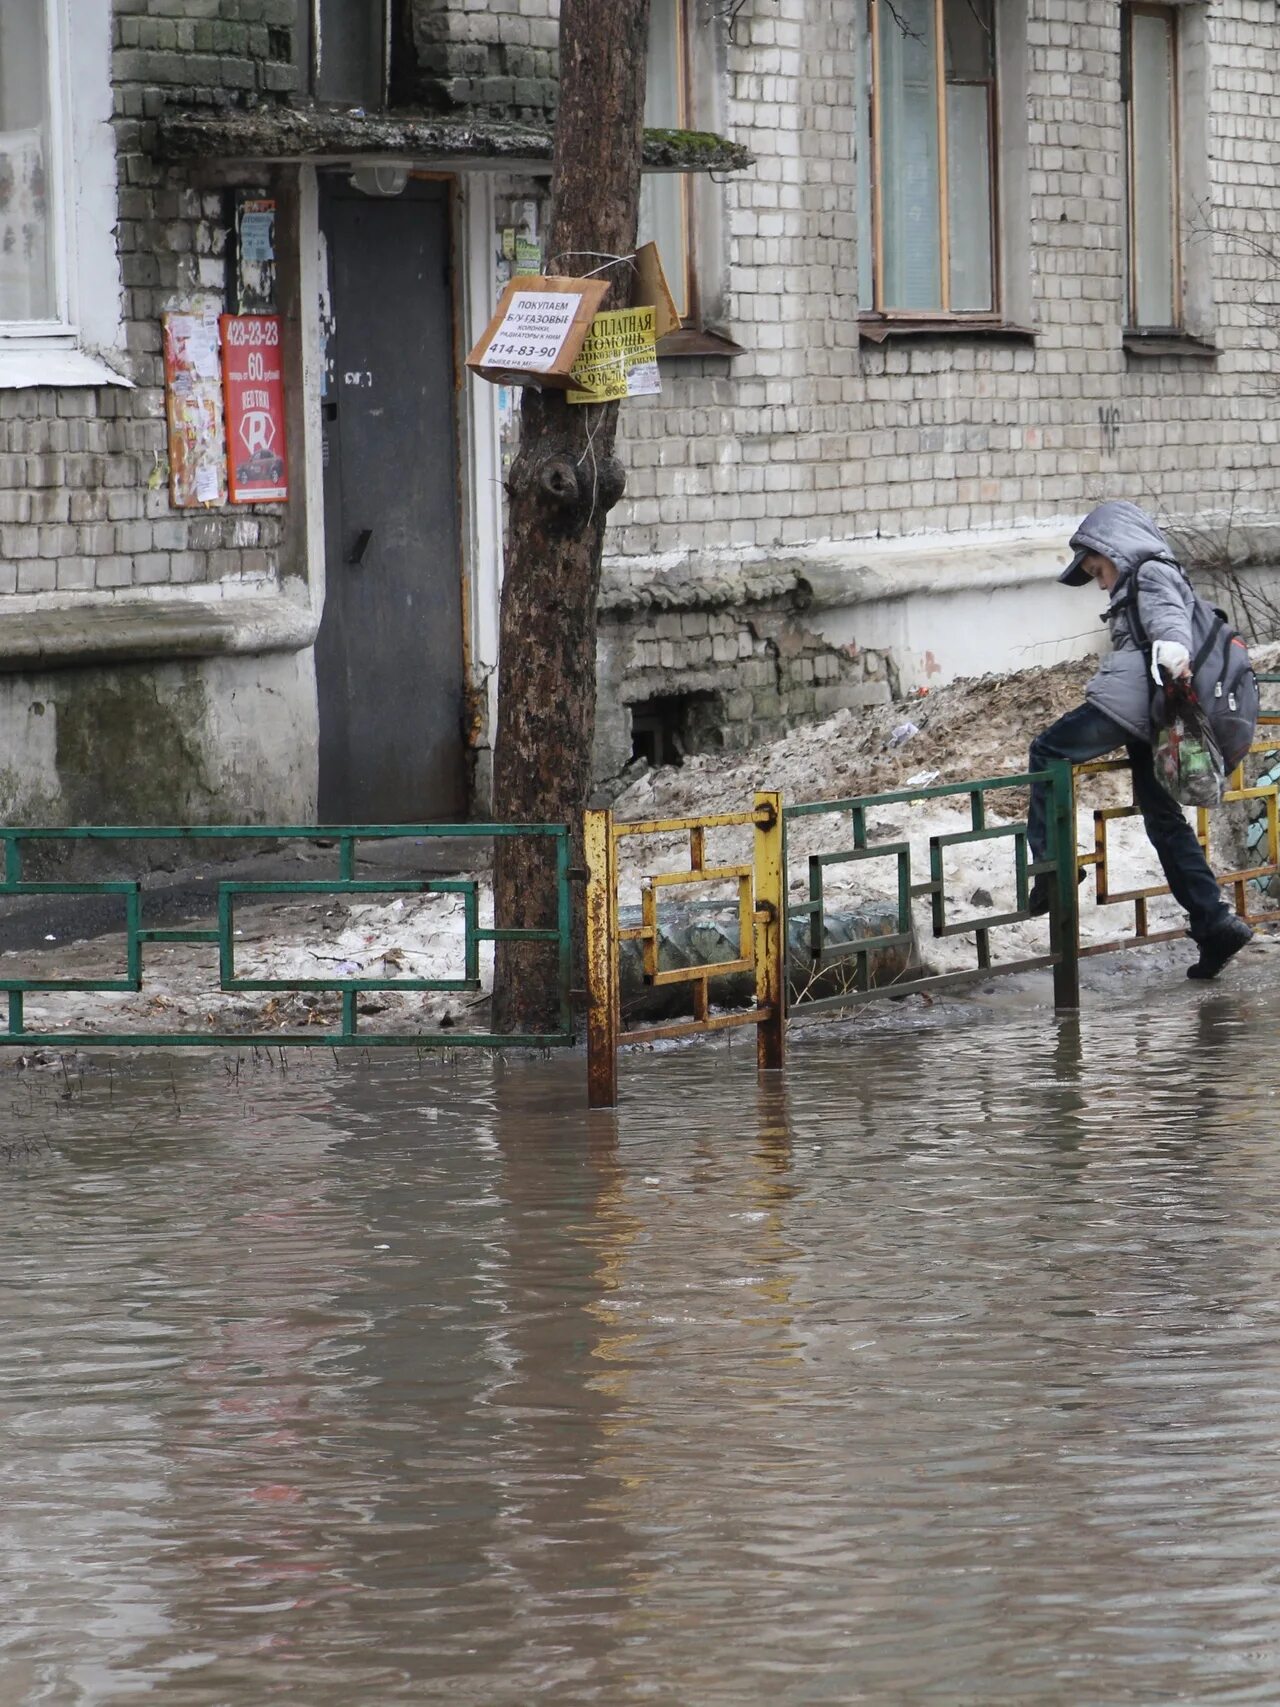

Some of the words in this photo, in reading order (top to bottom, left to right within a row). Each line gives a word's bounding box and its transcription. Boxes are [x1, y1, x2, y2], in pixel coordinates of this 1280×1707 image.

[518, 301, 568, 310] ПОКУПАЕМ
[524, 315, 569, 324] ГАЗОВЫЕ
[587, 313, 651, 338] СПЛАТНАЯ
[227, 321, 278, 346] 423-23-23
[582, 332, 645, 352] ПОМОЩЬ
[489, 343, 556, 357] 414-83-90
[248, 352, 263, 380] 60
